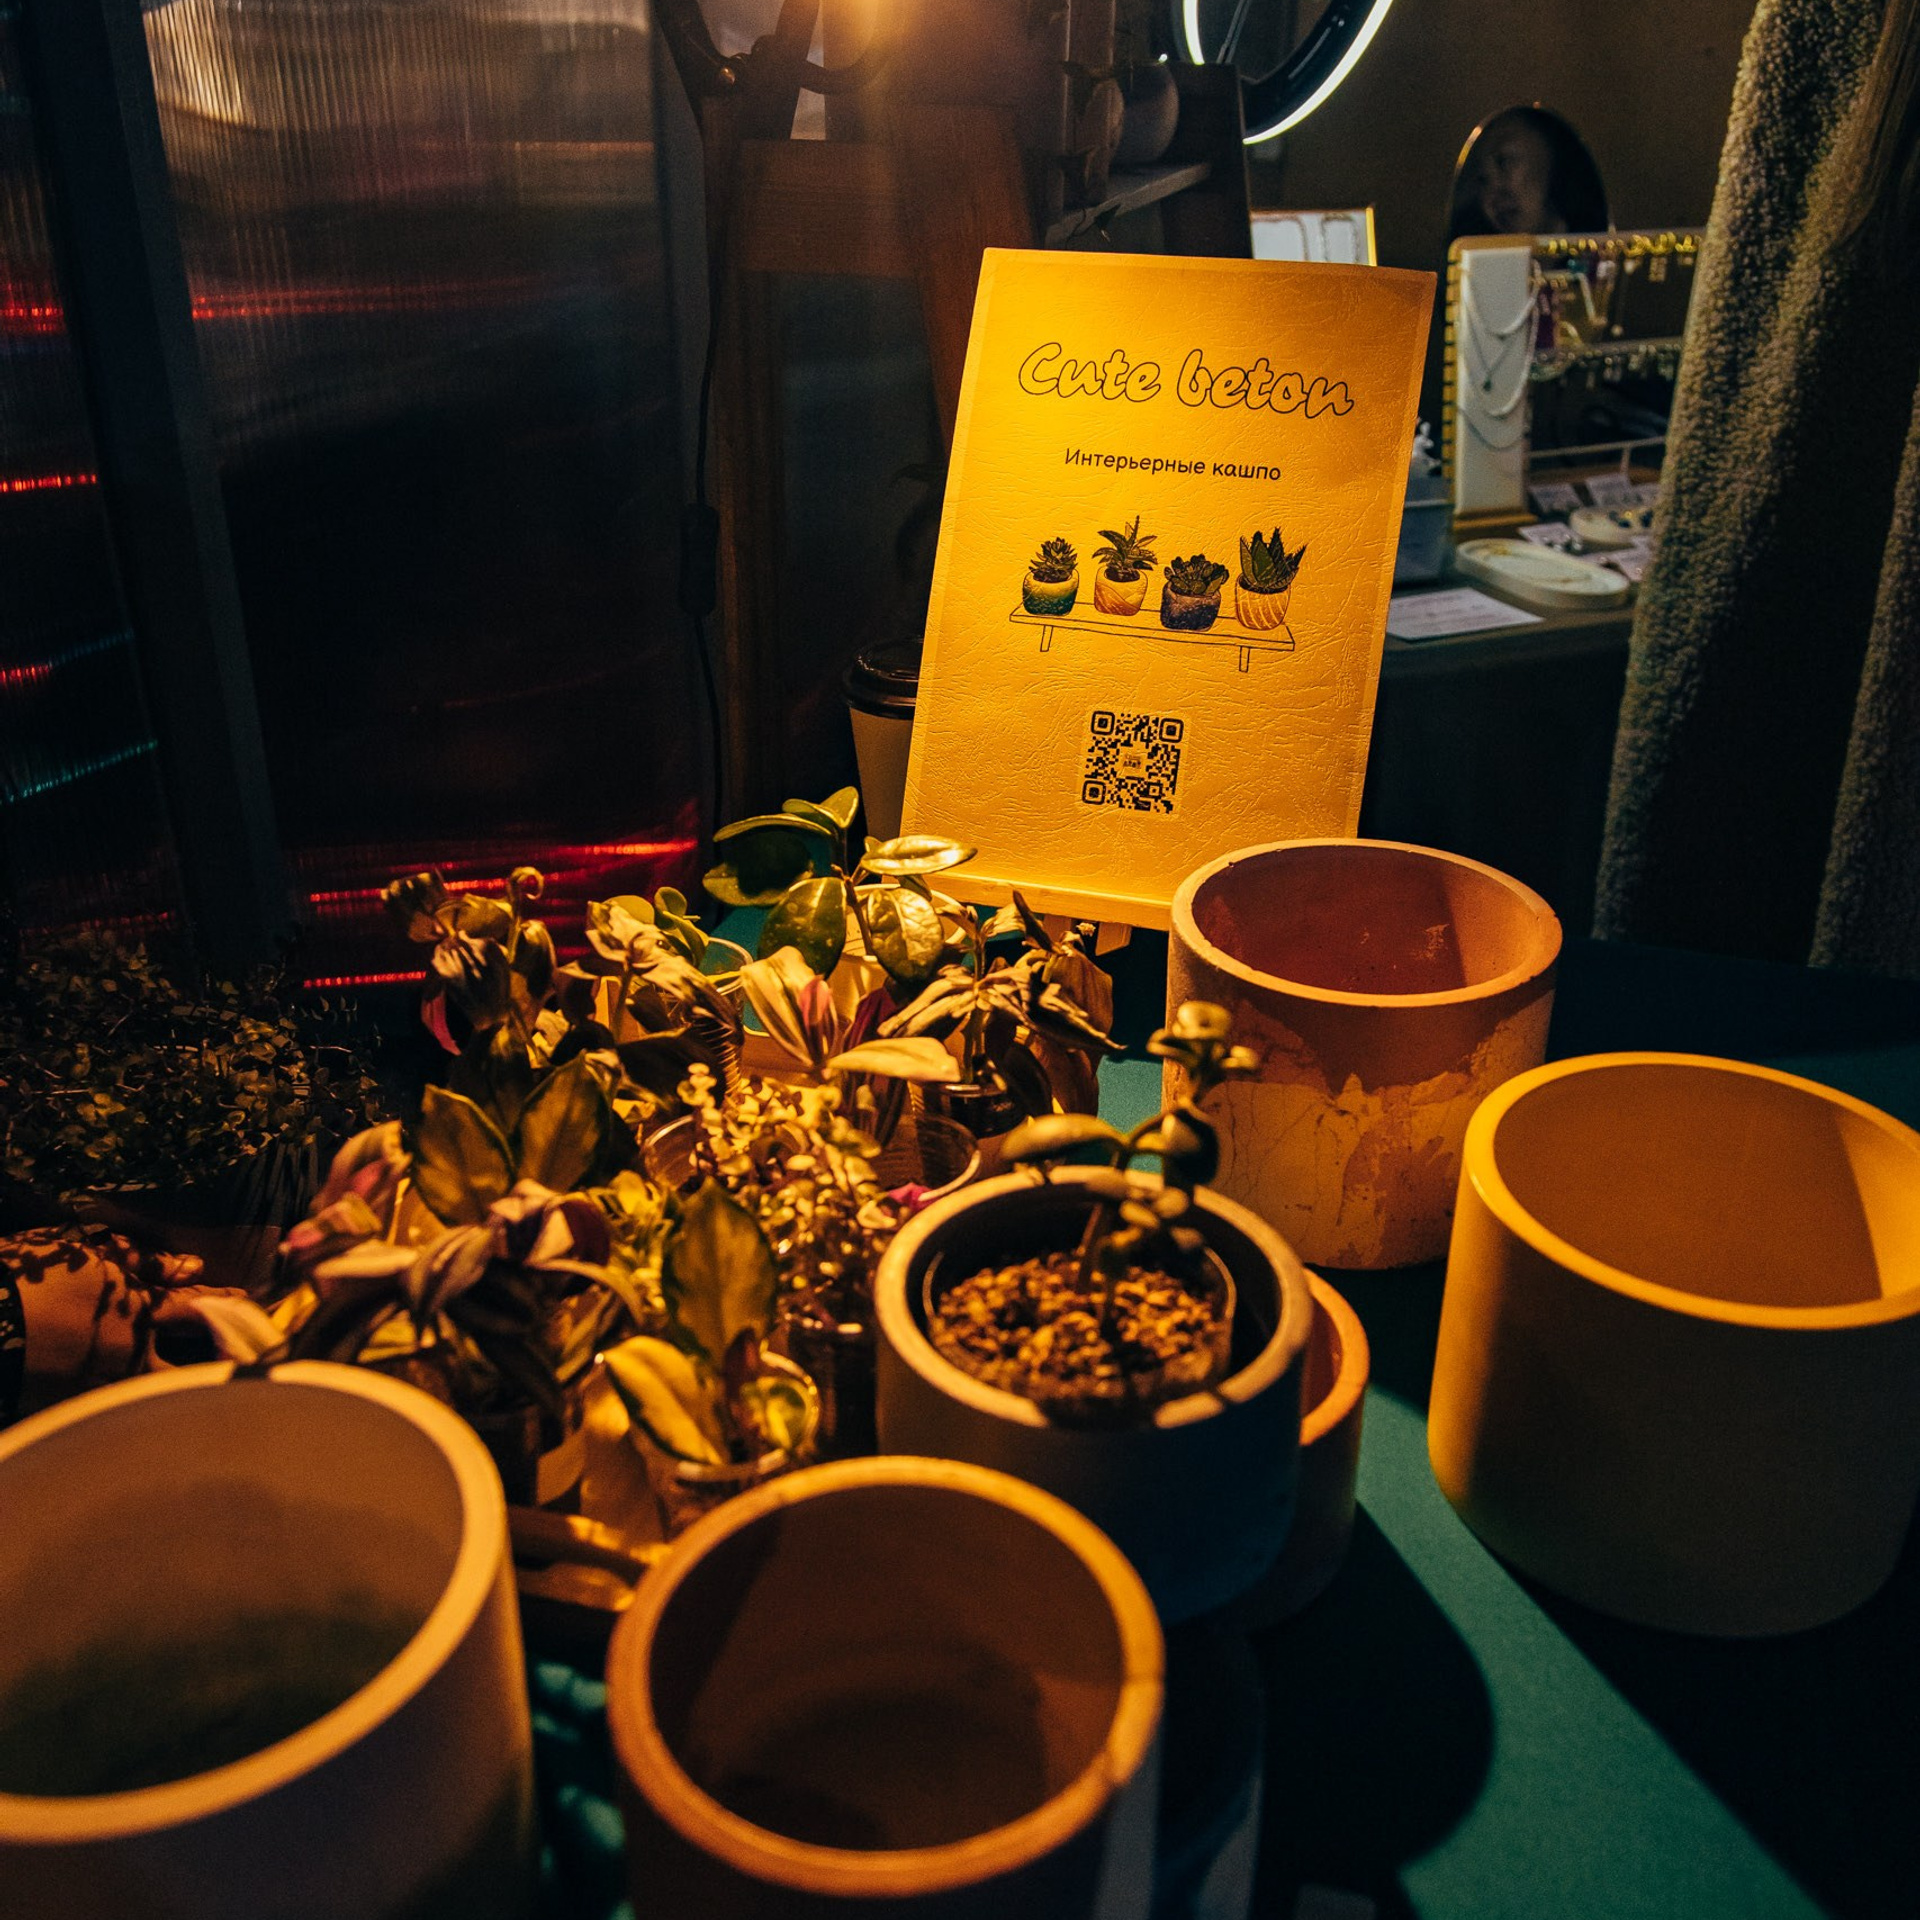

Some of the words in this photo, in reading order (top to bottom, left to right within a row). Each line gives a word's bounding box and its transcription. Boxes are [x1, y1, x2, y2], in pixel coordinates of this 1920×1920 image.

[1018, 342, 1161, 402] Cute
[1176, 348, 1354, 418] beton
[1065, 448, 1206, 474] Интерьерные
[1212, 462, 1281, 481] кашпо
